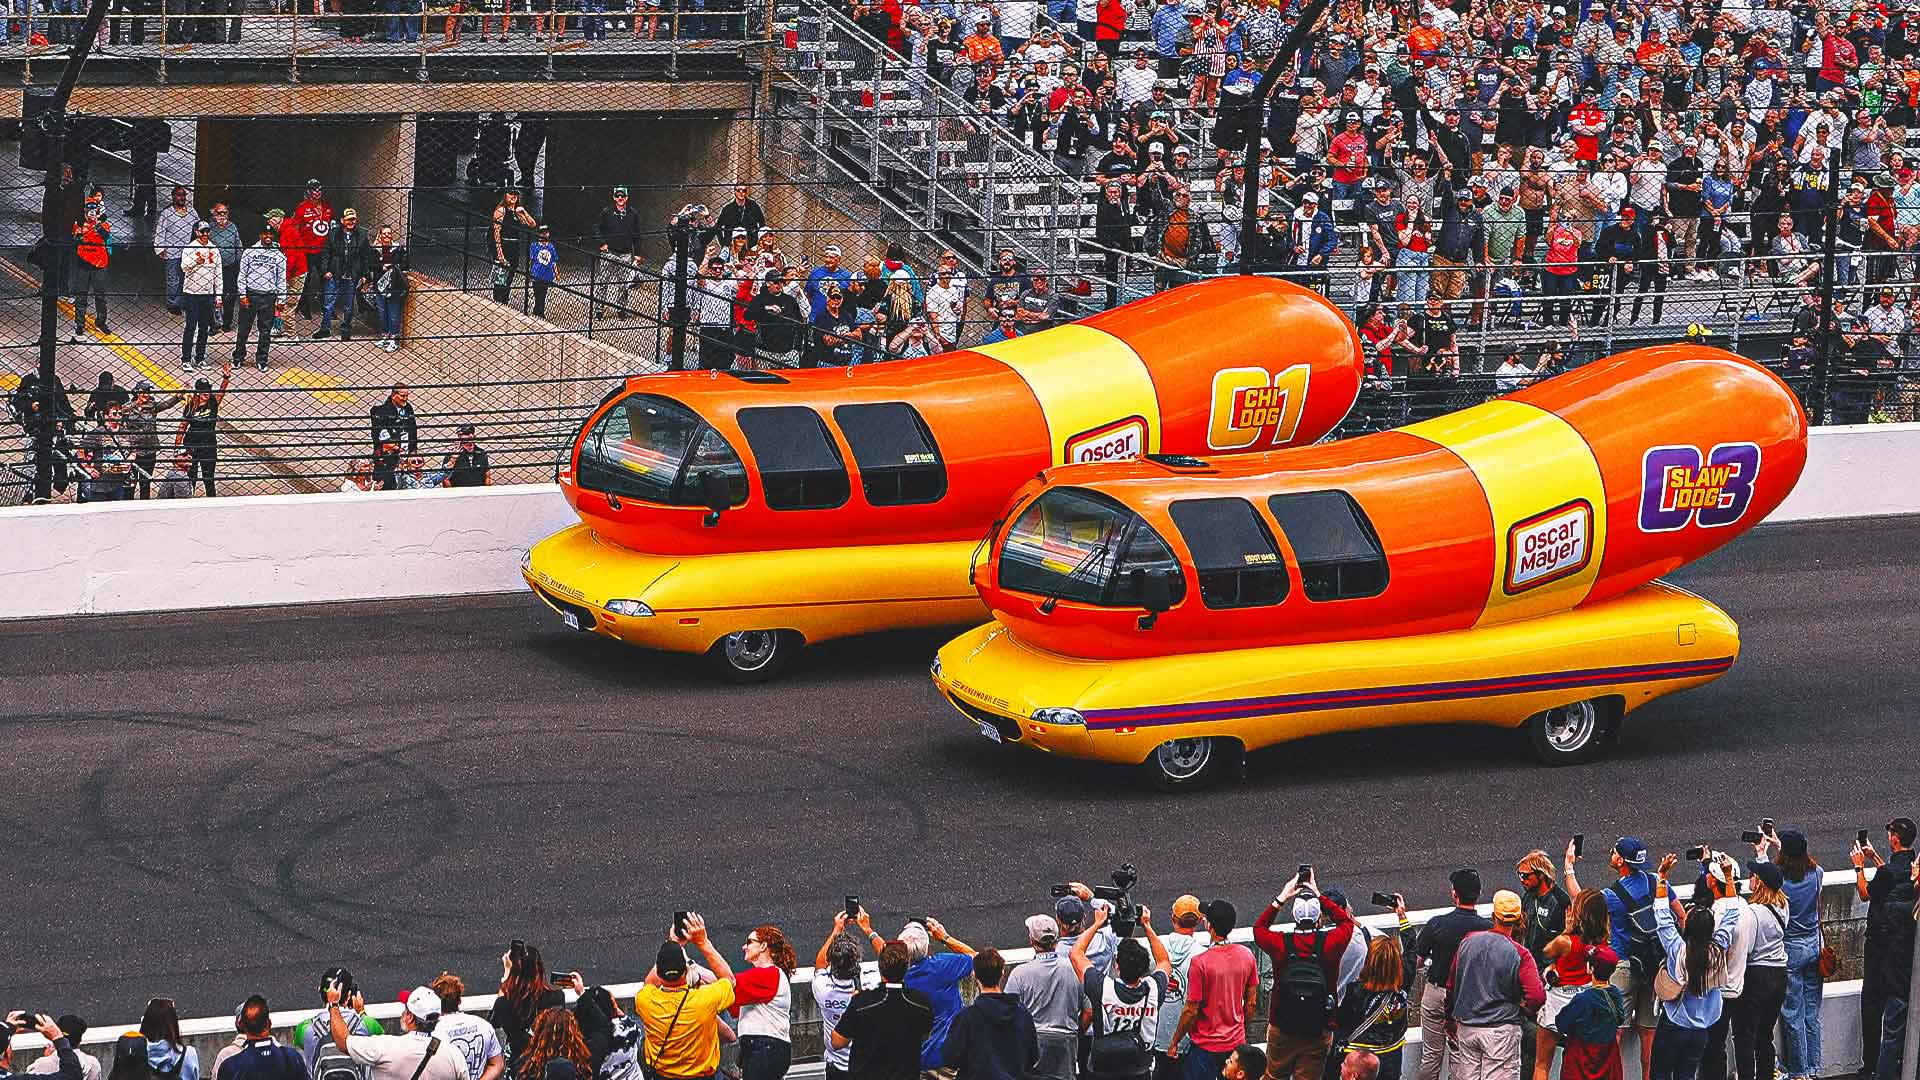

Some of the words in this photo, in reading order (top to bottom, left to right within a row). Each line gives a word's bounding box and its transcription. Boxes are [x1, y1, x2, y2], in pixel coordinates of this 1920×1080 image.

[1599, 274, 1610, 289] 32
[1244, 387, 1279, 408] CHI
[1238, 407, 1280, 428] DOG
[1670, 465, 1730, 488] SLAW
[1677, 487, 1719, 508] DOG
[1524, 519, 1578, 553] Oscar
[1519, 536, 1580, 573] Mayer
[825, 999, 847, 1009] aes
